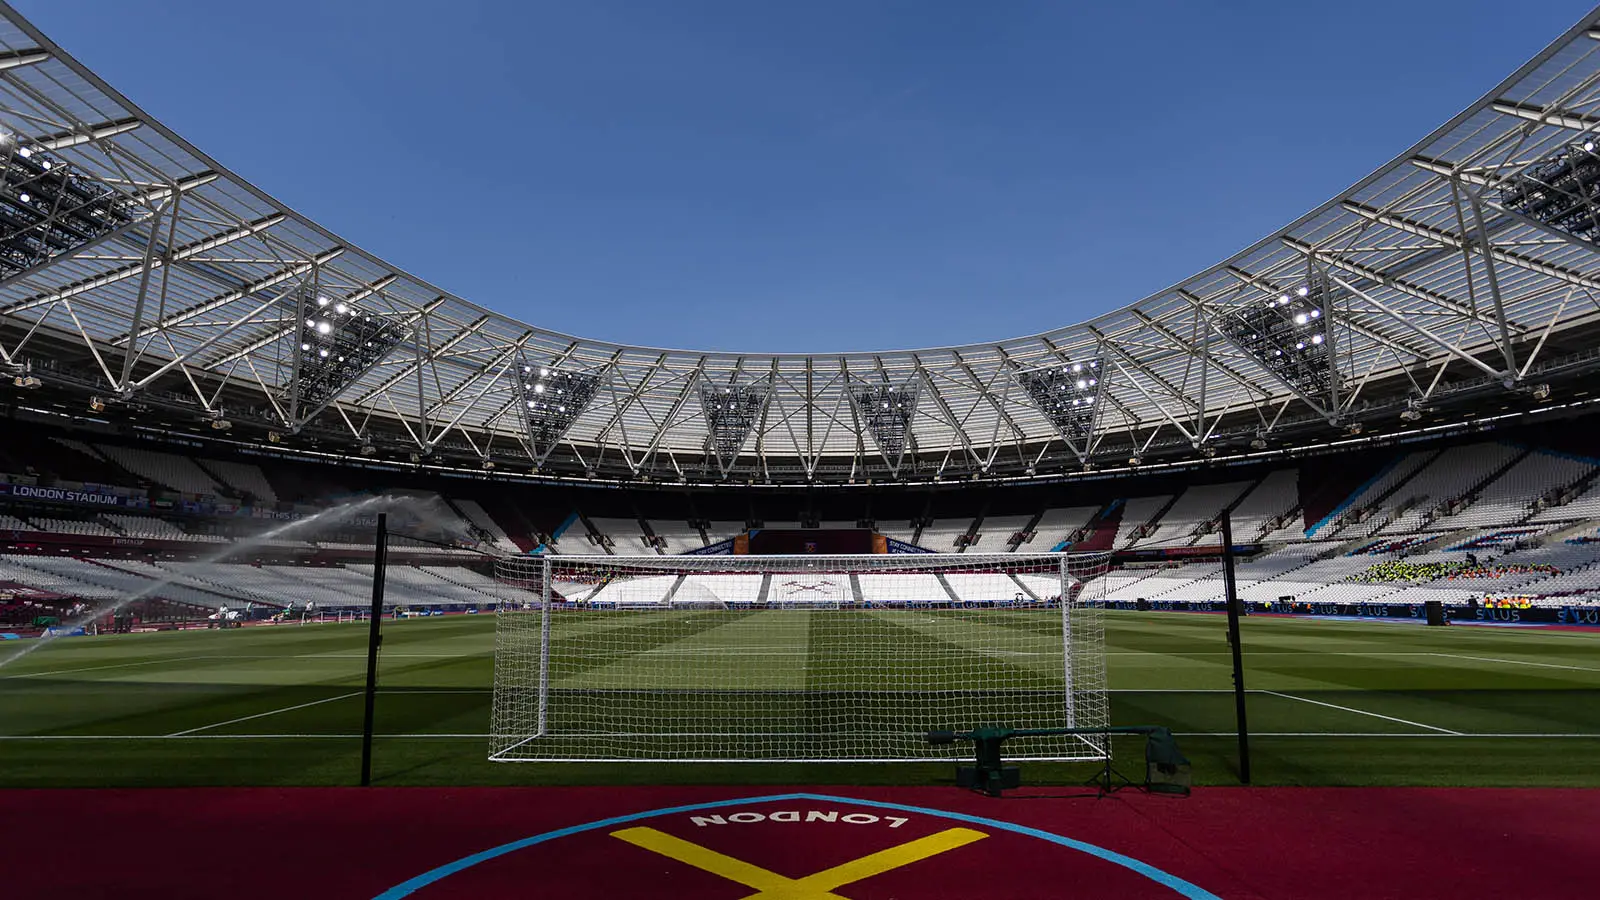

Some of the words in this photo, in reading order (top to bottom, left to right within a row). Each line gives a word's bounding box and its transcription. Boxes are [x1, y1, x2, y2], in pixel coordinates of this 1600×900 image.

[13, 485, 64, 500] LONDON
[66, 491, 117, 505] STADIUM
[689, 810, 909, 828] LONDON
